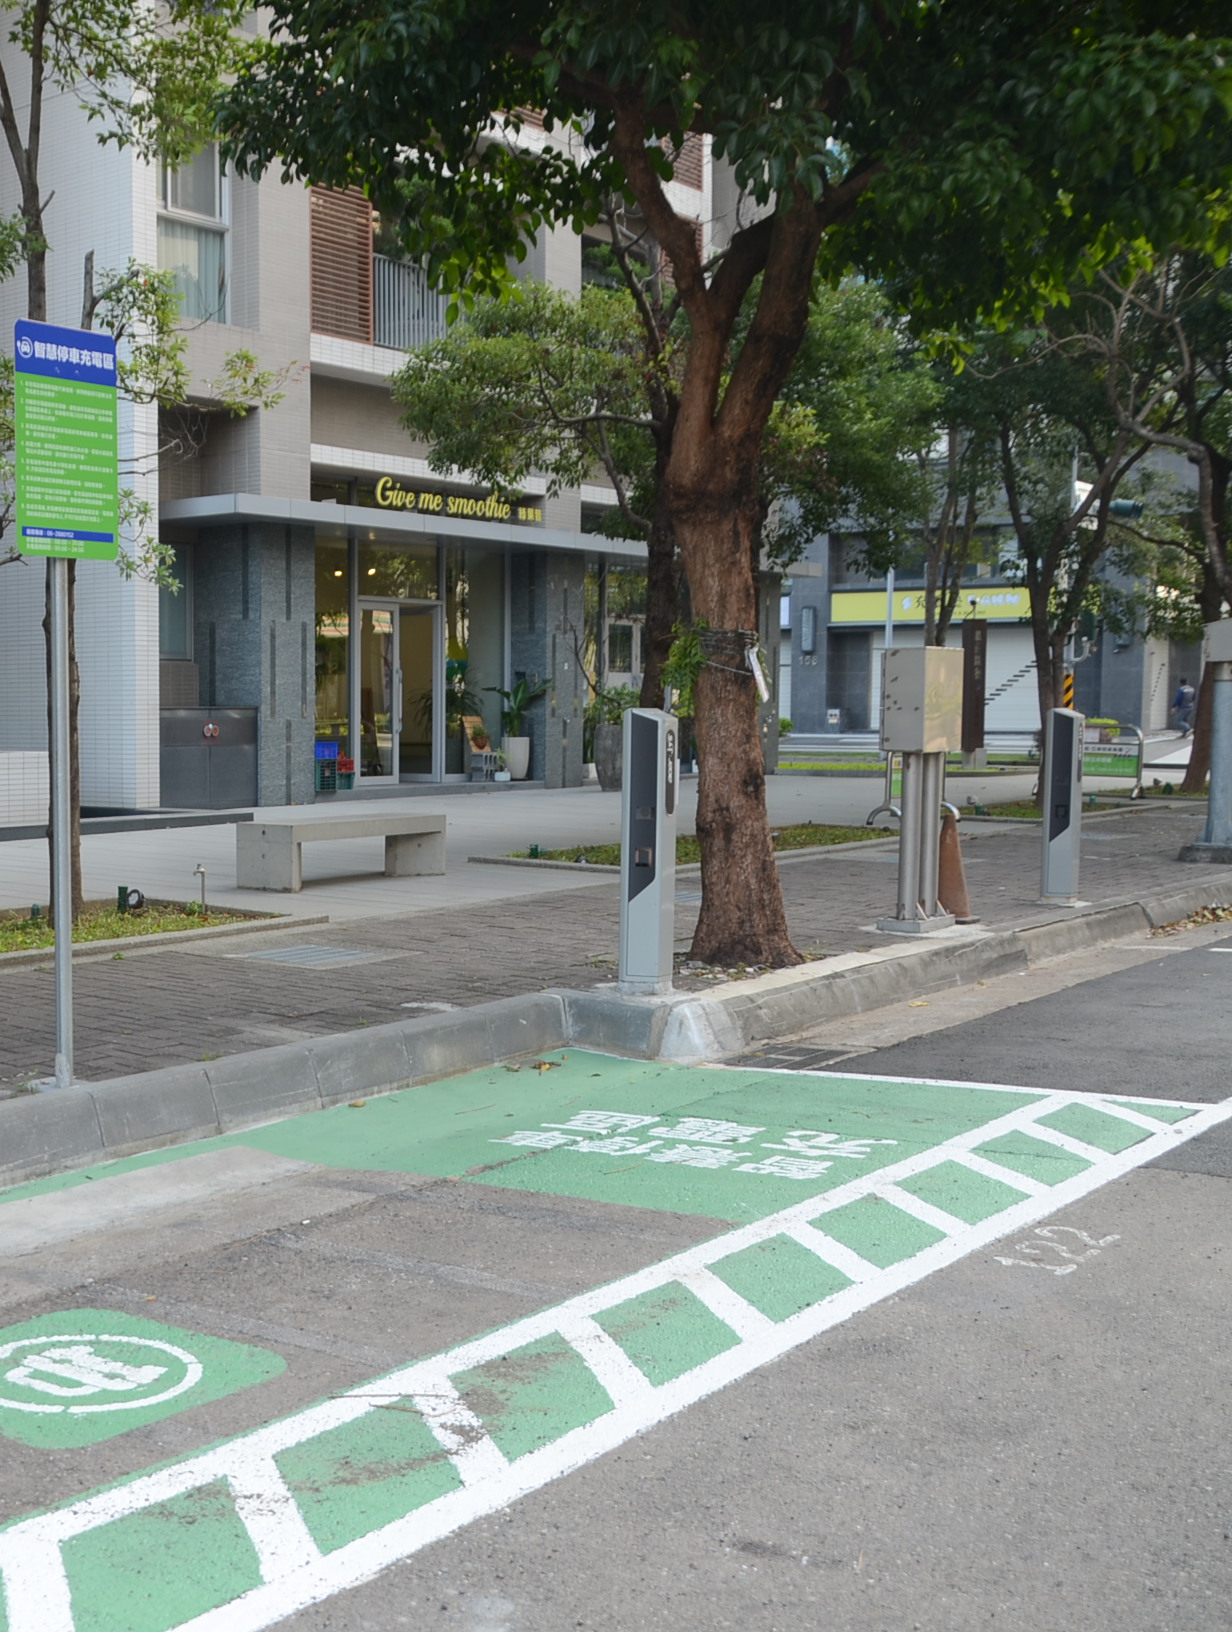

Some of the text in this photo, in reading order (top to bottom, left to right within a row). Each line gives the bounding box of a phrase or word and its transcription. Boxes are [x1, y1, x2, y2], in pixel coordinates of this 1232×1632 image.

[34, 340, 114, 370] 智慧停車充電區
[376, 476, 511, 520] Give me smoothie
[488, 1128, 834, 1180] 智慧停車
[540, 1110, 898, 1158] 充電區
